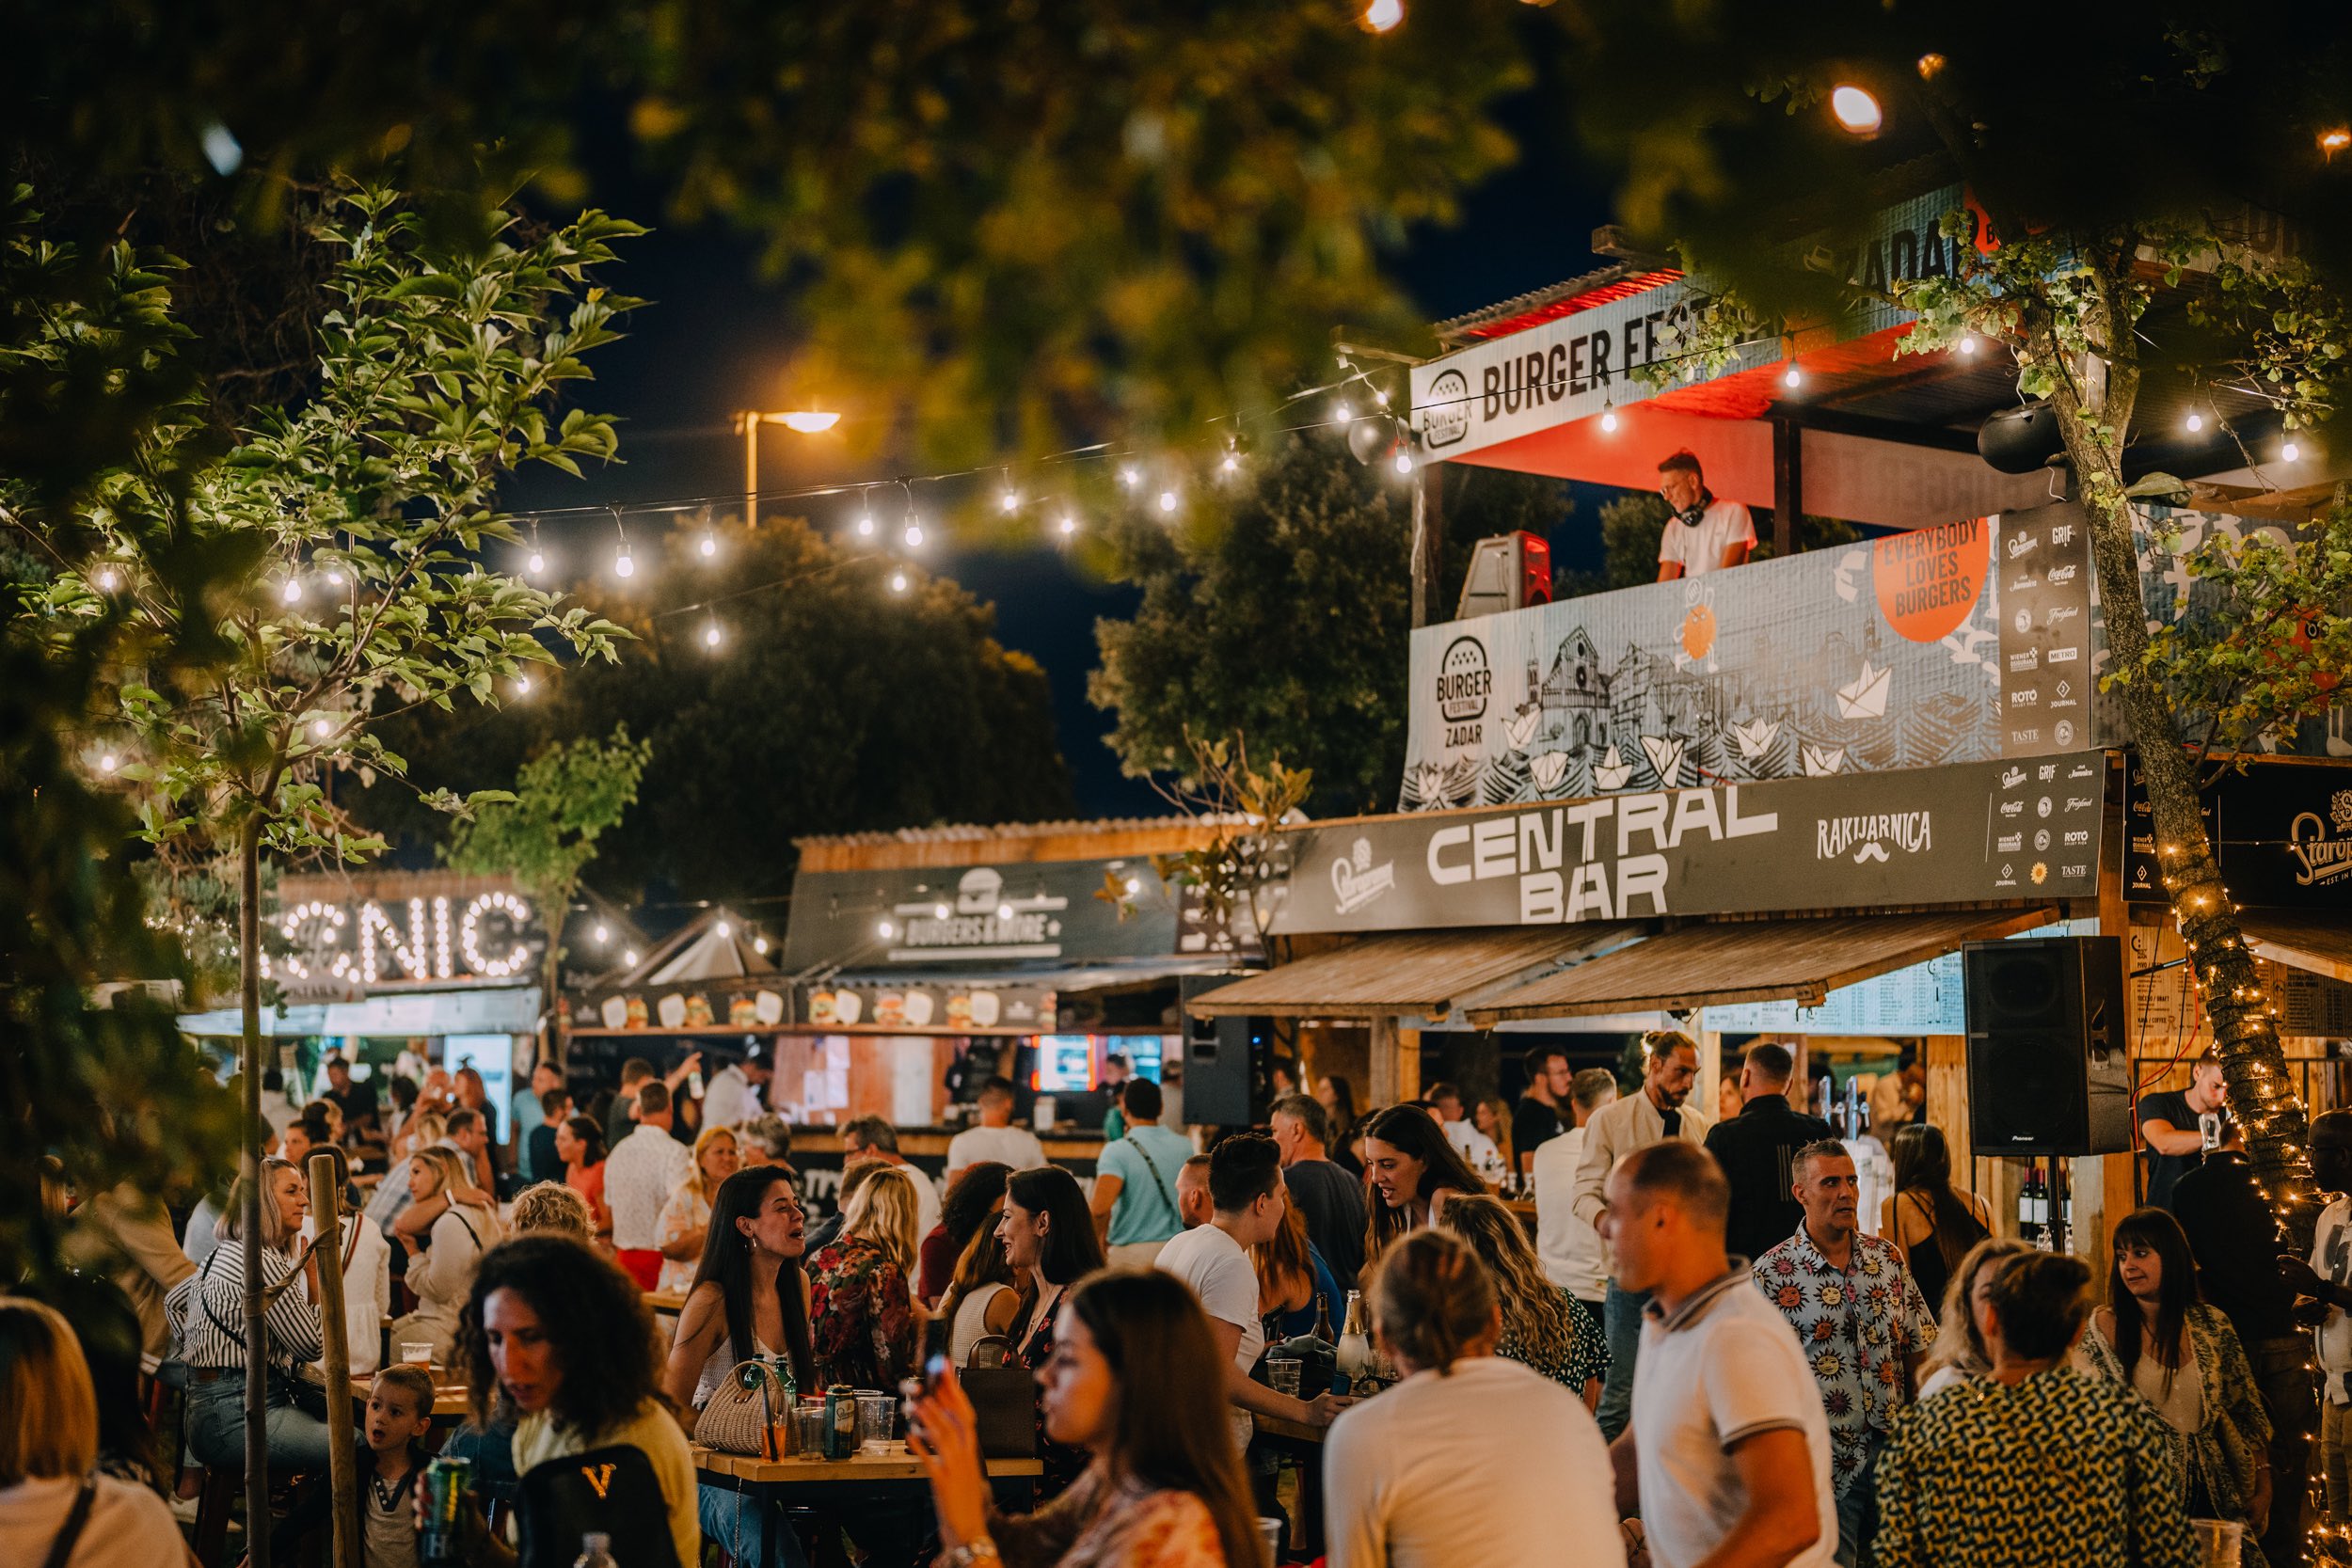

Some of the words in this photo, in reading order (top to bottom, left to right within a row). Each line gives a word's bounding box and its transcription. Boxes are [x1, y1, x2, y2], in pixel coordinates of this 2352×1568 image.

[1484, 329, 1612, 422] BURGER
[1883, 518, 1979, 565] EVERYBODY
[1906, 551, 1959, 588] LOVES
[1896, 576, 1972, 618] BURGERS
[2050, 650, 2075, 660] METRO
[1437, 669, 1492, 702] BURGER
[1449, 700, 1479, 714] FESTIVAL
[2050, 699, 2077, 709] JOURNAL
[1445, 723, 1483, 748] ZADAR
[2011, 729, 2039, 742] TASTE
[1427, 785, 1778, 885] CENTRAL
[1817, 811, 1931, 860] RAKIJARNICA
[2061, 864, 2087, 876] TASTE
[1520, 855, 1668, 925] BAR
